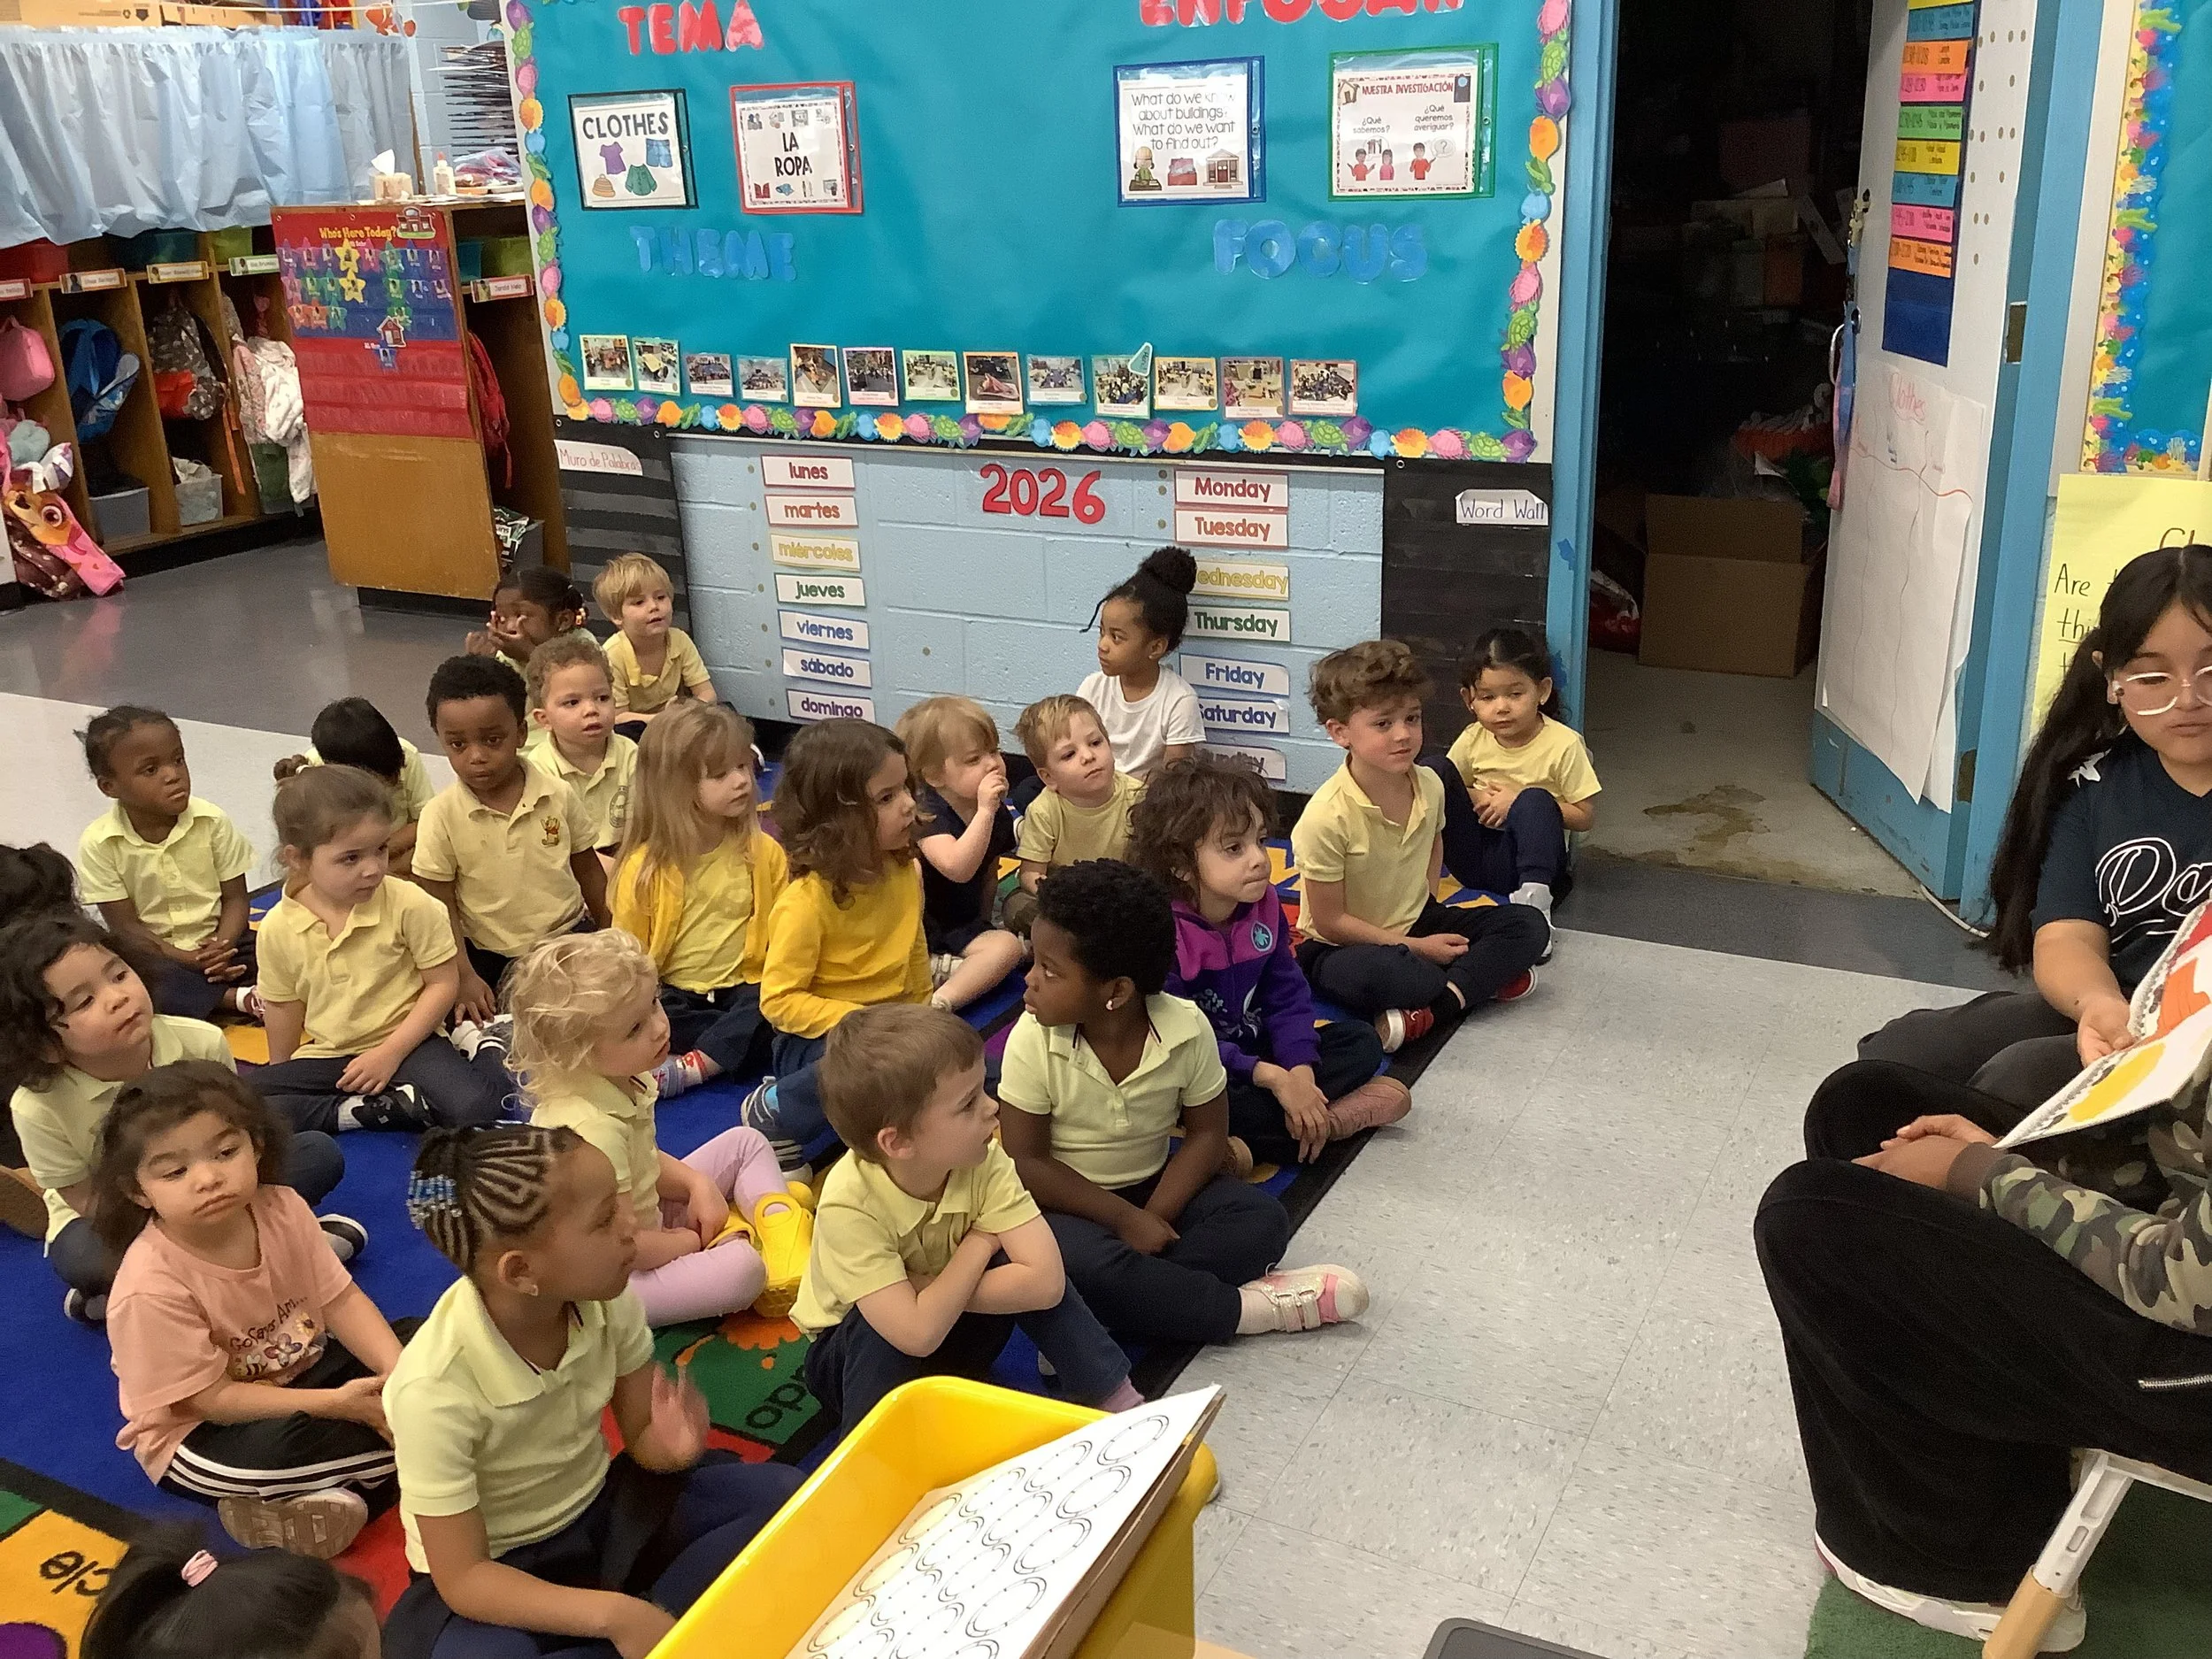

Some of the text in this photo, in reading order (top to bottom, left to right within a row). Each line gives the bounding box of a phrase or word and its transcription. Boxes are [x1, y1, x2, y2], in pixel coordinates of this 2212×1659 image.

[617, 0, 764, 56] TEMA
[1363, 81, 1453, 95] NUESTRA INVESTIGACIÓN
[1132, 92, 1236, 106] What do we knw
[1425, 104, 1444, 114] ¿Qué
[1139, 107, 1175, 120] about
[1362, 117, 1382, 126] ¿Qué
[1415, 114, 1453, 123] queremos
[582, 111, 669, 140] CLOTHES
[1133, 120, 1236, 135] What do we want
[1353, 125, 1390, 134] sabemos?
[1414, 122, 1454, 132] averiguar?
[782, 132, 799, 152] LA
[1151, 135, 1218, 150] to find out?
[774, 156, 812, 177] ROPA
[319, 227, 342, 239] Who's
[364, 225, 396, 242] Today?
[629, 226, 796, 282] THEME
[1213, 219, 1427, 285] FOCUS
[559, 448, 641, 471] Muro de Palabras
[789, 462, 828, 480] lunes
[980, 464, 1105, 525] 2026
[1194, 477, 1271, 503] Monday
[784, 502, 841, 518] martes
[1460, 498, 1545, 519] Word Wall
[1194, 517, 1271, 541] Tuesday
[779, 541, 854, 562] miércoles
[795, 580, 845, 600] jueves
[1198, 567, 1288, 594] ednesday
[2054, 563, 2091, 597] Are
[796, 620, 853, 641] viernes
[1194, 612, 1278, 637] Thursday
[2056, 608, 2093, 639] thi
[801, 657, 854, 679] sábado
[1205, 663, 1264, 689] Friday
